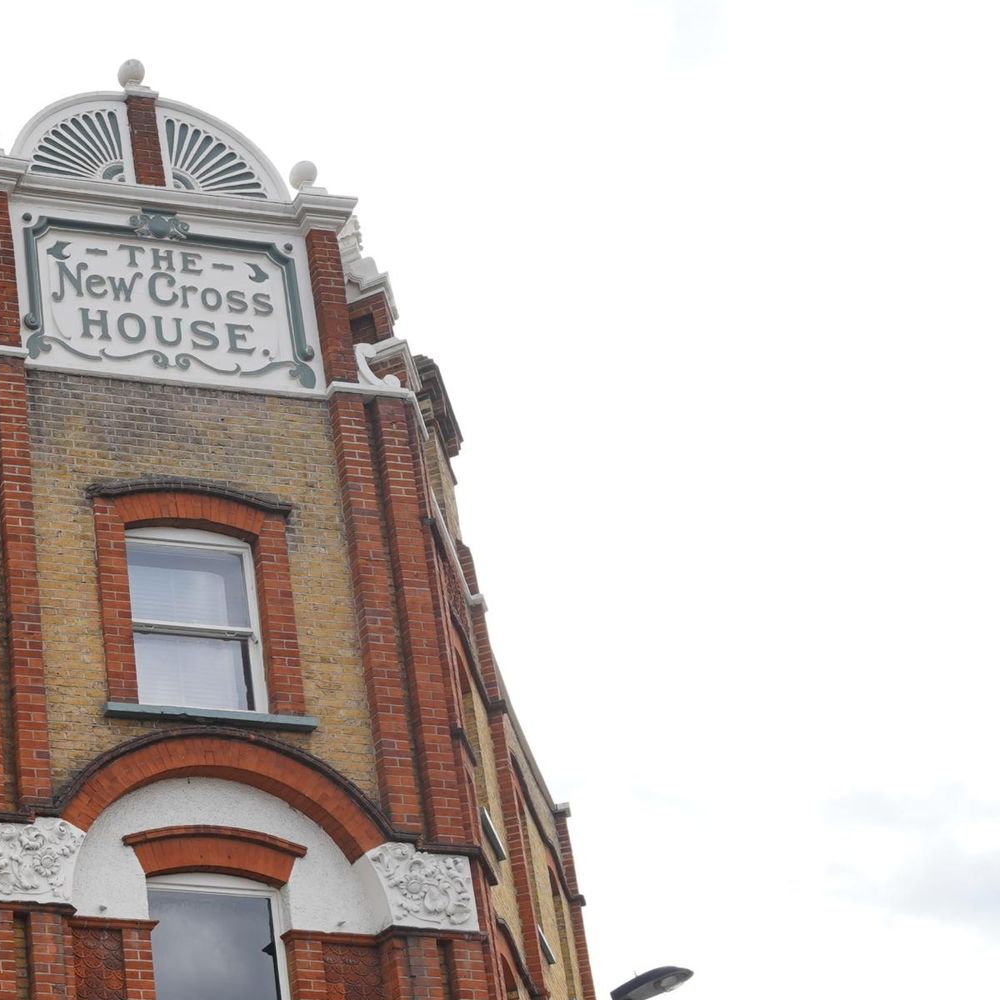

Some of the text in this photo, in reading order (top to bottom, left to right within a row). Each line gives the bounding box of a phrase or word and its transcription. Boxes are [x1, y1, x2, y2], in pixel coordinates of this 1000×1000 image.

[118, 244, 203, 273] THE
[52, 261, 274, 317] New Cross
